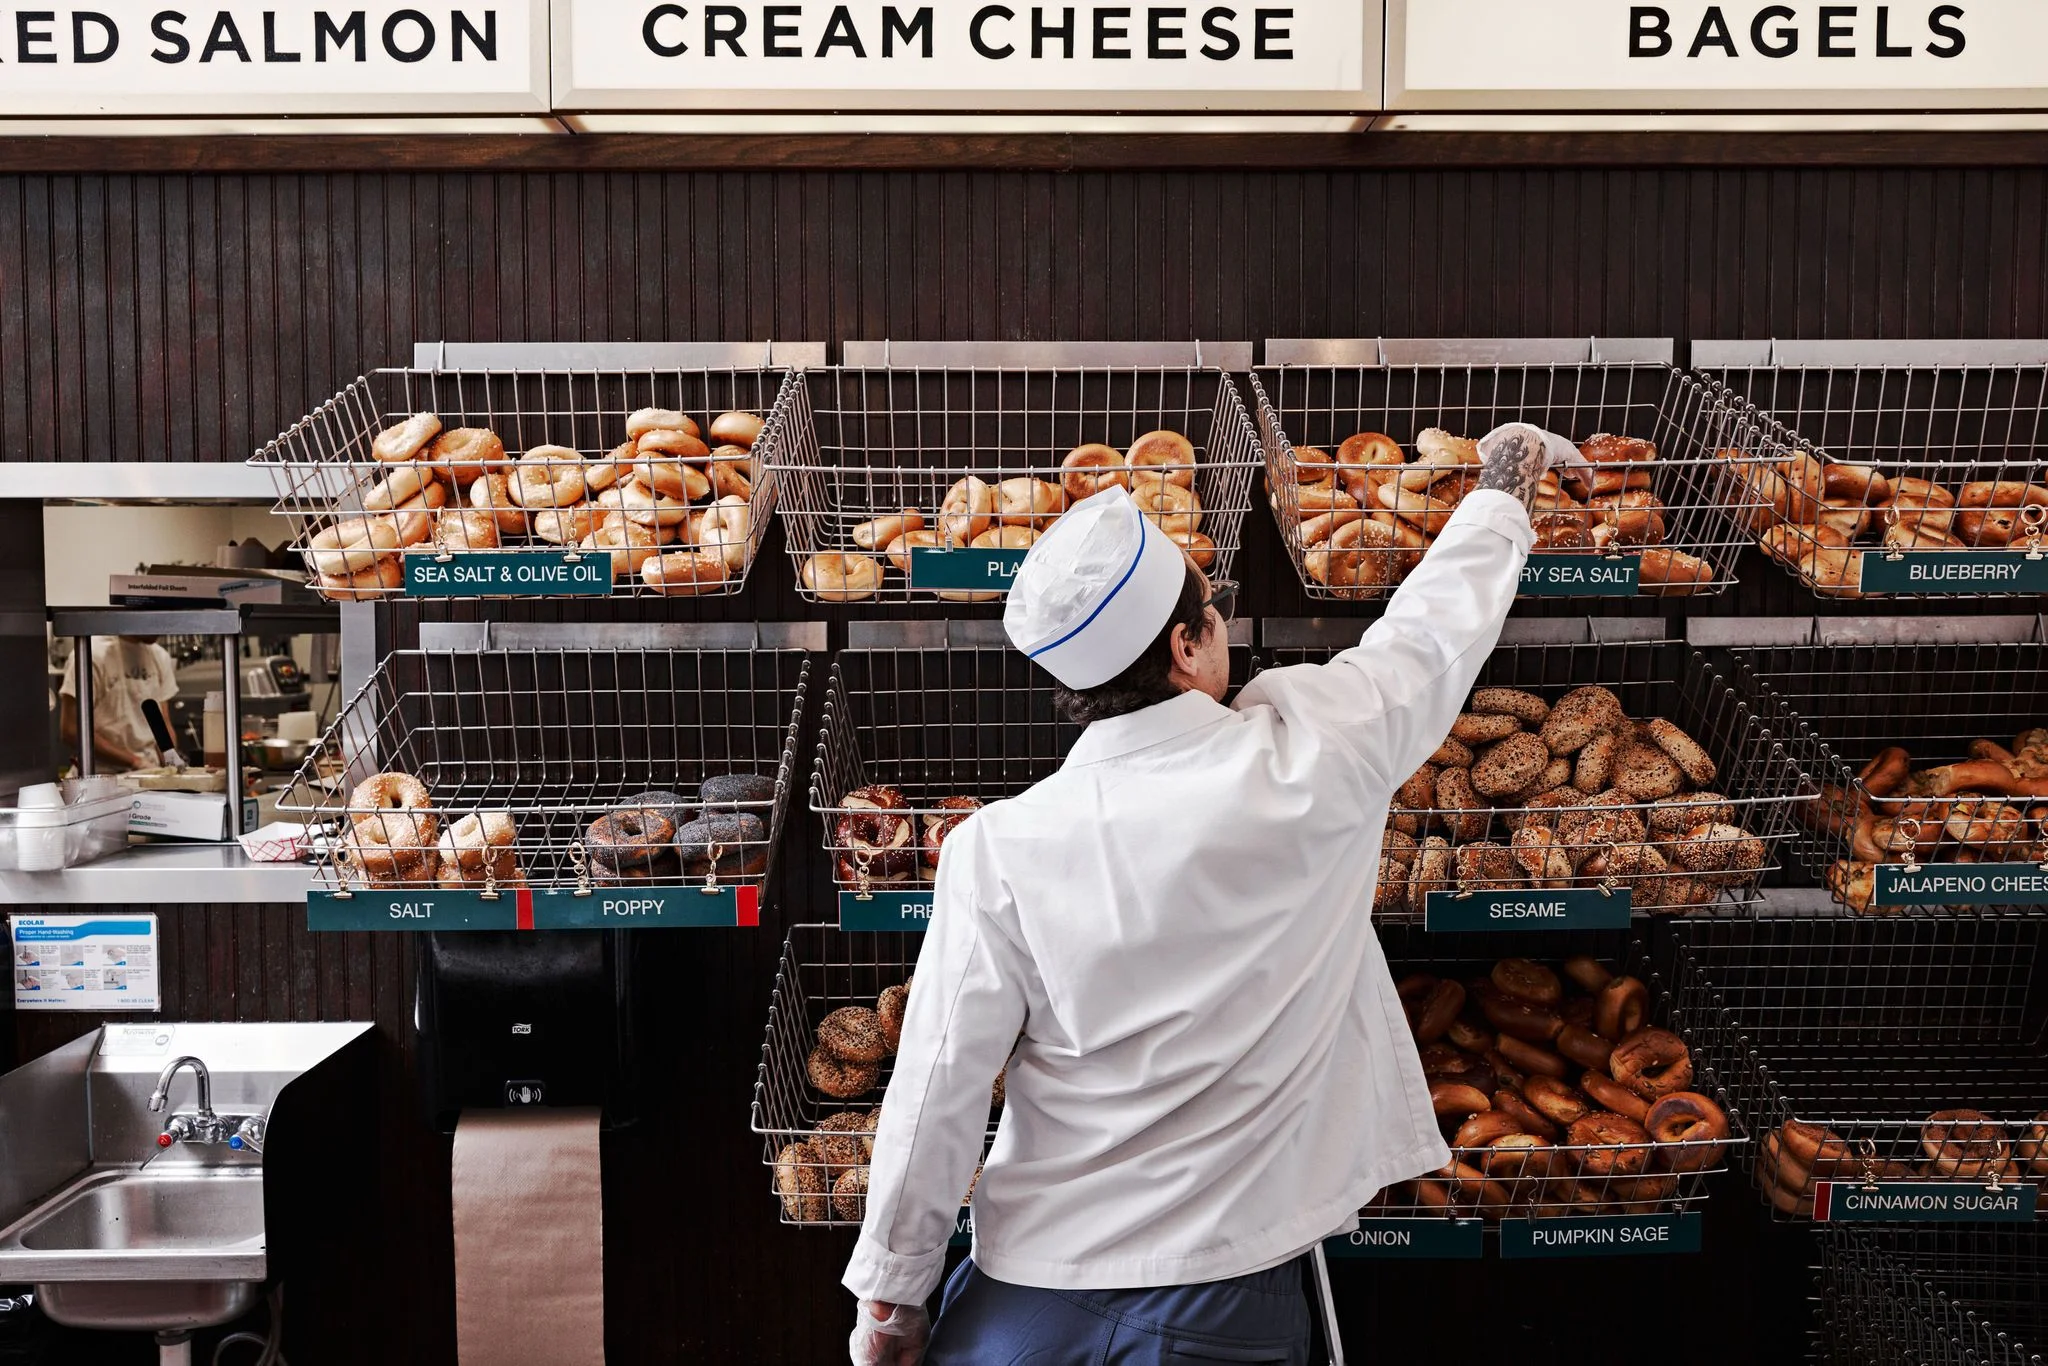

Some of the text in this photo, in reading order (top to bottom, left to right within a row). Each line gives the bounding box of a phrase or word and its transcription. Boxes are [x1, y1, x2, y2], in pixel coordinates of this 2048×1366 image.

[0, 9, 496, 63] ED SALMON
[643, 4, 1293, 60] CREAM CHEESE
[1629, 5, 1965, 58] BAGELS
[415, 565, 602, 584] SEA SALT & OLIVE OIL
[1548, 567, 1585, 583] SEA
[1590, 566, 1634, 583] SALT
[1909, 564, 2021, 581] BLUEBERRY
[132, 813, 152, 821] Grade
[1888, 877, 1986, 893] JALAPENO
[390, 902, 434, 919] SALT
[603, 899, 665, 916] POPPY
[1489, 902, 1567, 918] SESAME
[1845, 1194, 2019, 1212] CINNAMON SUGAR
[1350, 1230, 1411, 1247] ONION
[1533, 1226, 1669, 1246] PUMPKIN SAGE
